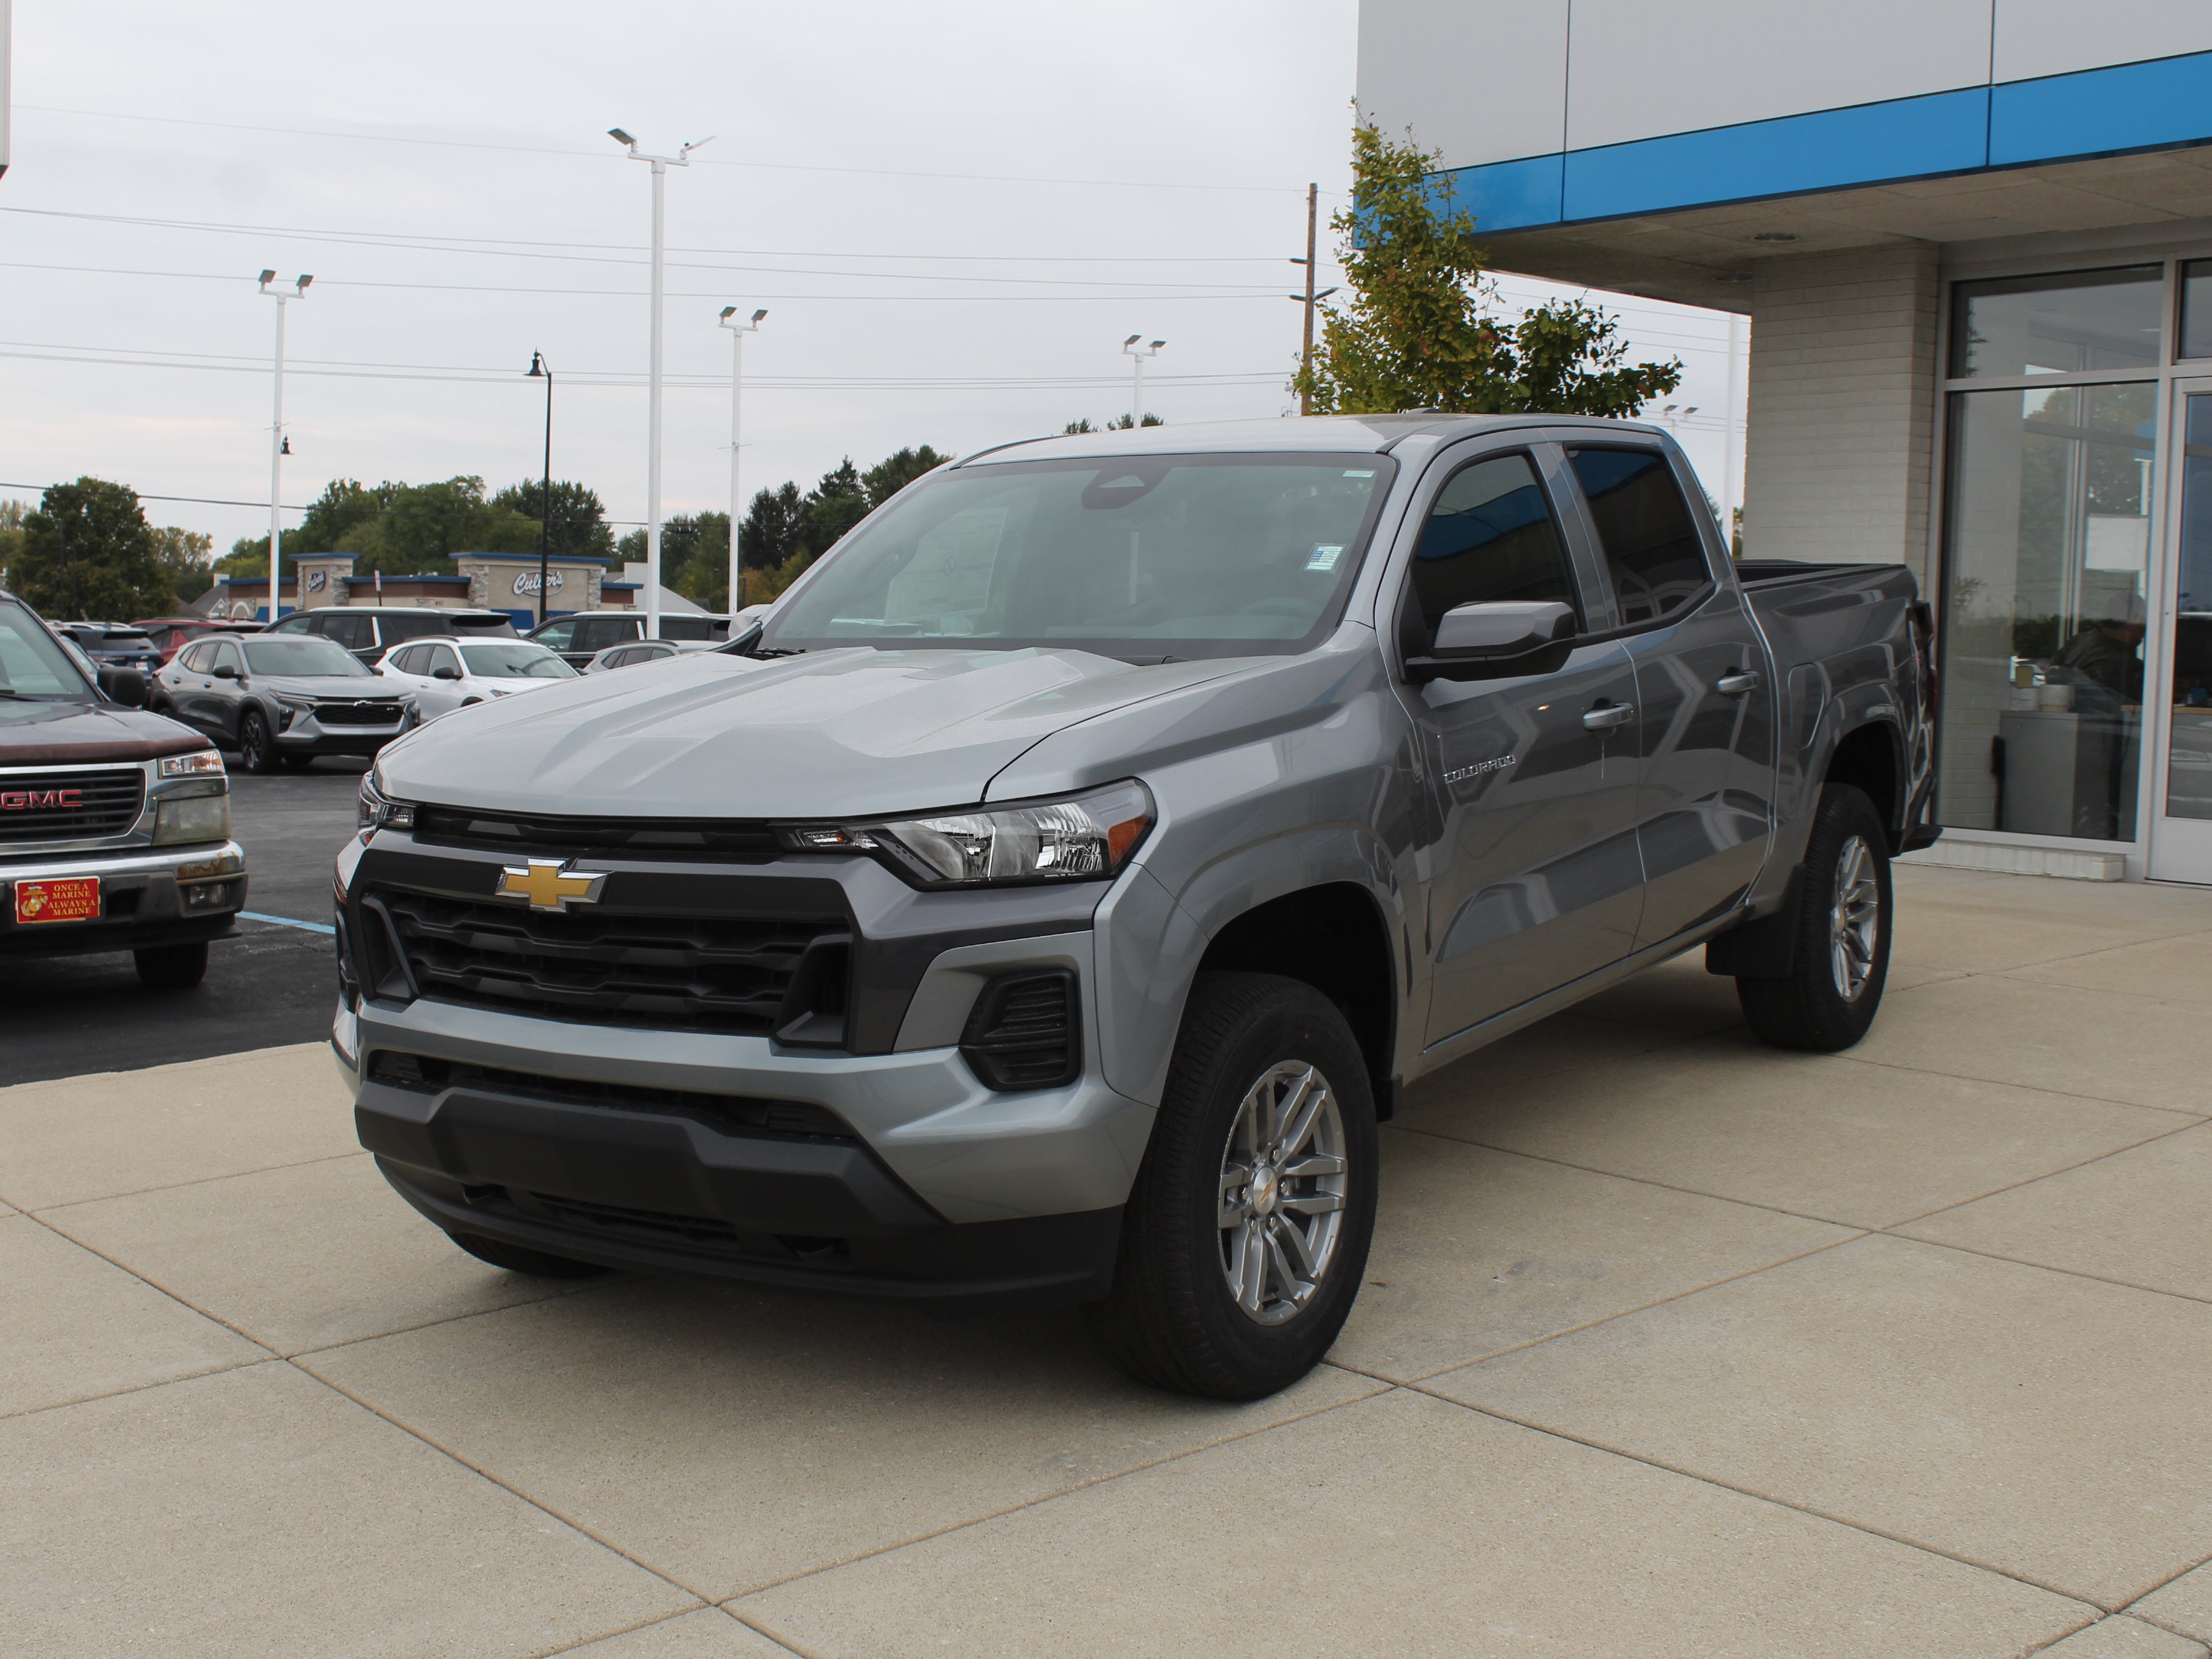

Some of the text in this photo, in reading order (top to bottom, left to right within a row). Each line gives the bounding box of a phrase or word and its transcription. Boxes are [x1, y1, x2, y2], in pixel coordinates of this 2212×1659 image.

[1443, 755, 1516, 784] COLORADO
[1, 789, 83, 809] GMC
[54, 884, 80, 892] ONCE
[53, 891, 91, 899] MARINE
[48, 900, 86, 909] ALWAYS
[53, 907, 91, 916] MARINE
